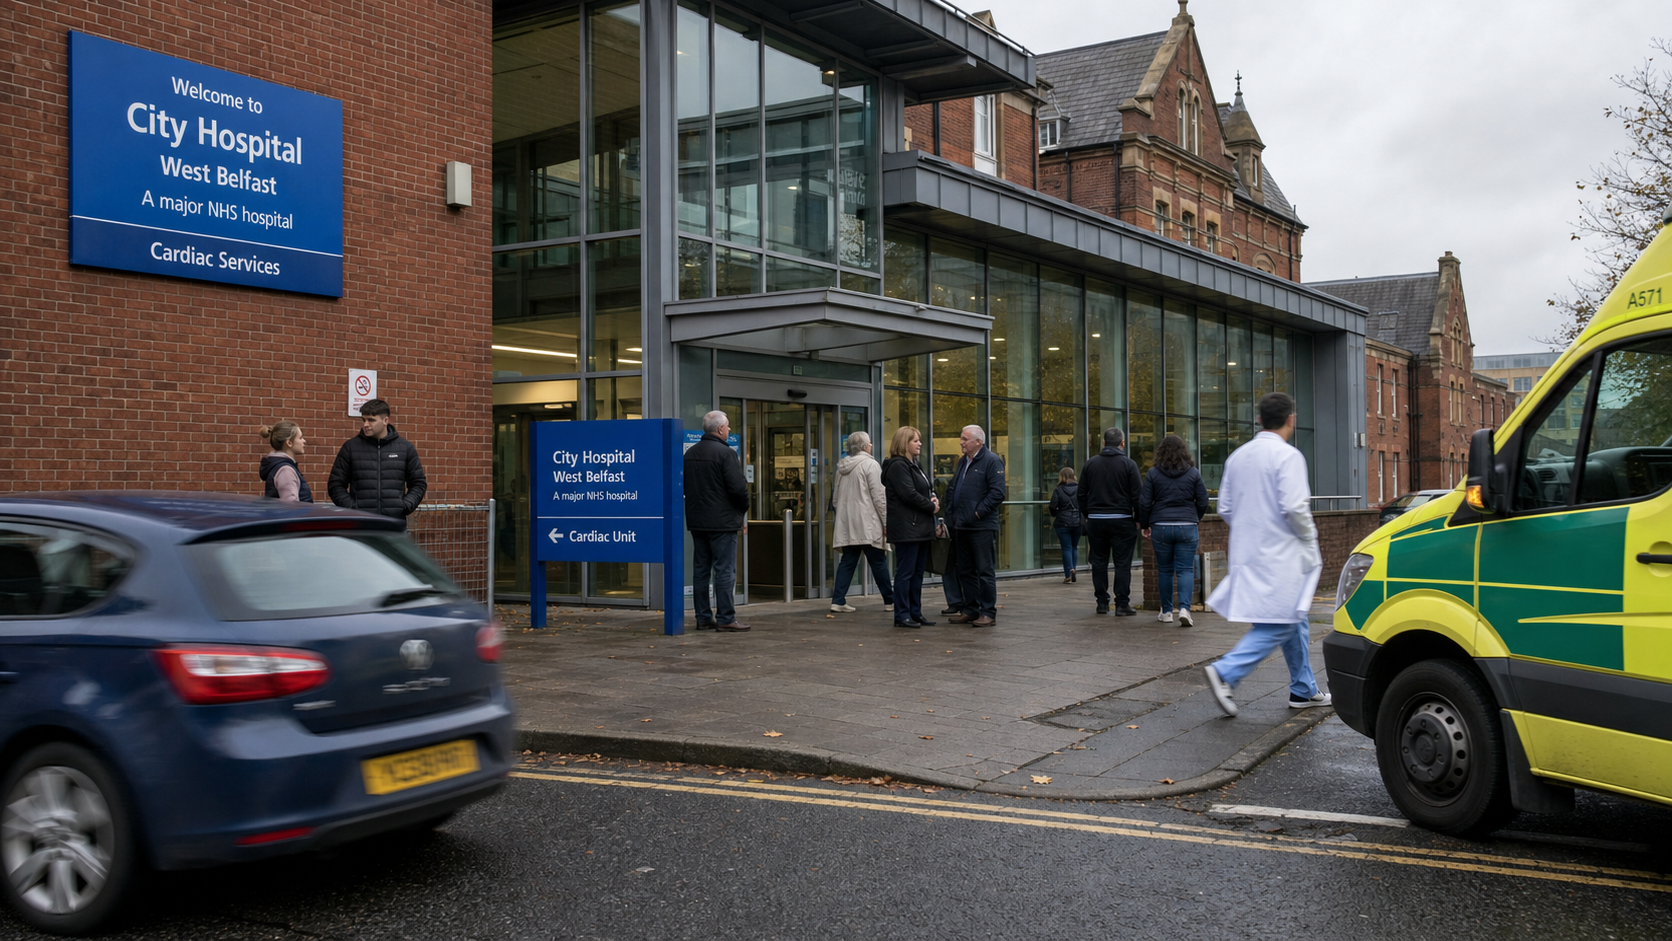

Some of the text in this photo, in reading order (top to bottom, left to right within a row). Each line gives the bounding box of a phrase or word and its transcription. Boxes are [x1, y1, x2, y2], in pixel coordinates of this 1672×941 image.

[171, 76, 263, 115] Welcome to
[126, 101, 302, 165] City Hospital
[160, 154, 277, 196] West Belfast
[141, 189, 293, 230] A major NHS hospital
[150, 241, 281, 276] Cardiac Services
[1627, 287, 1662, 310] A571
[552, 449, 635, 468] City Hospital
[553, 470, 626, 483] West Belfast
[553, 490, 638, 502] A major NHS hospital
[569, 530, 636, 542] Cardiac Unit
